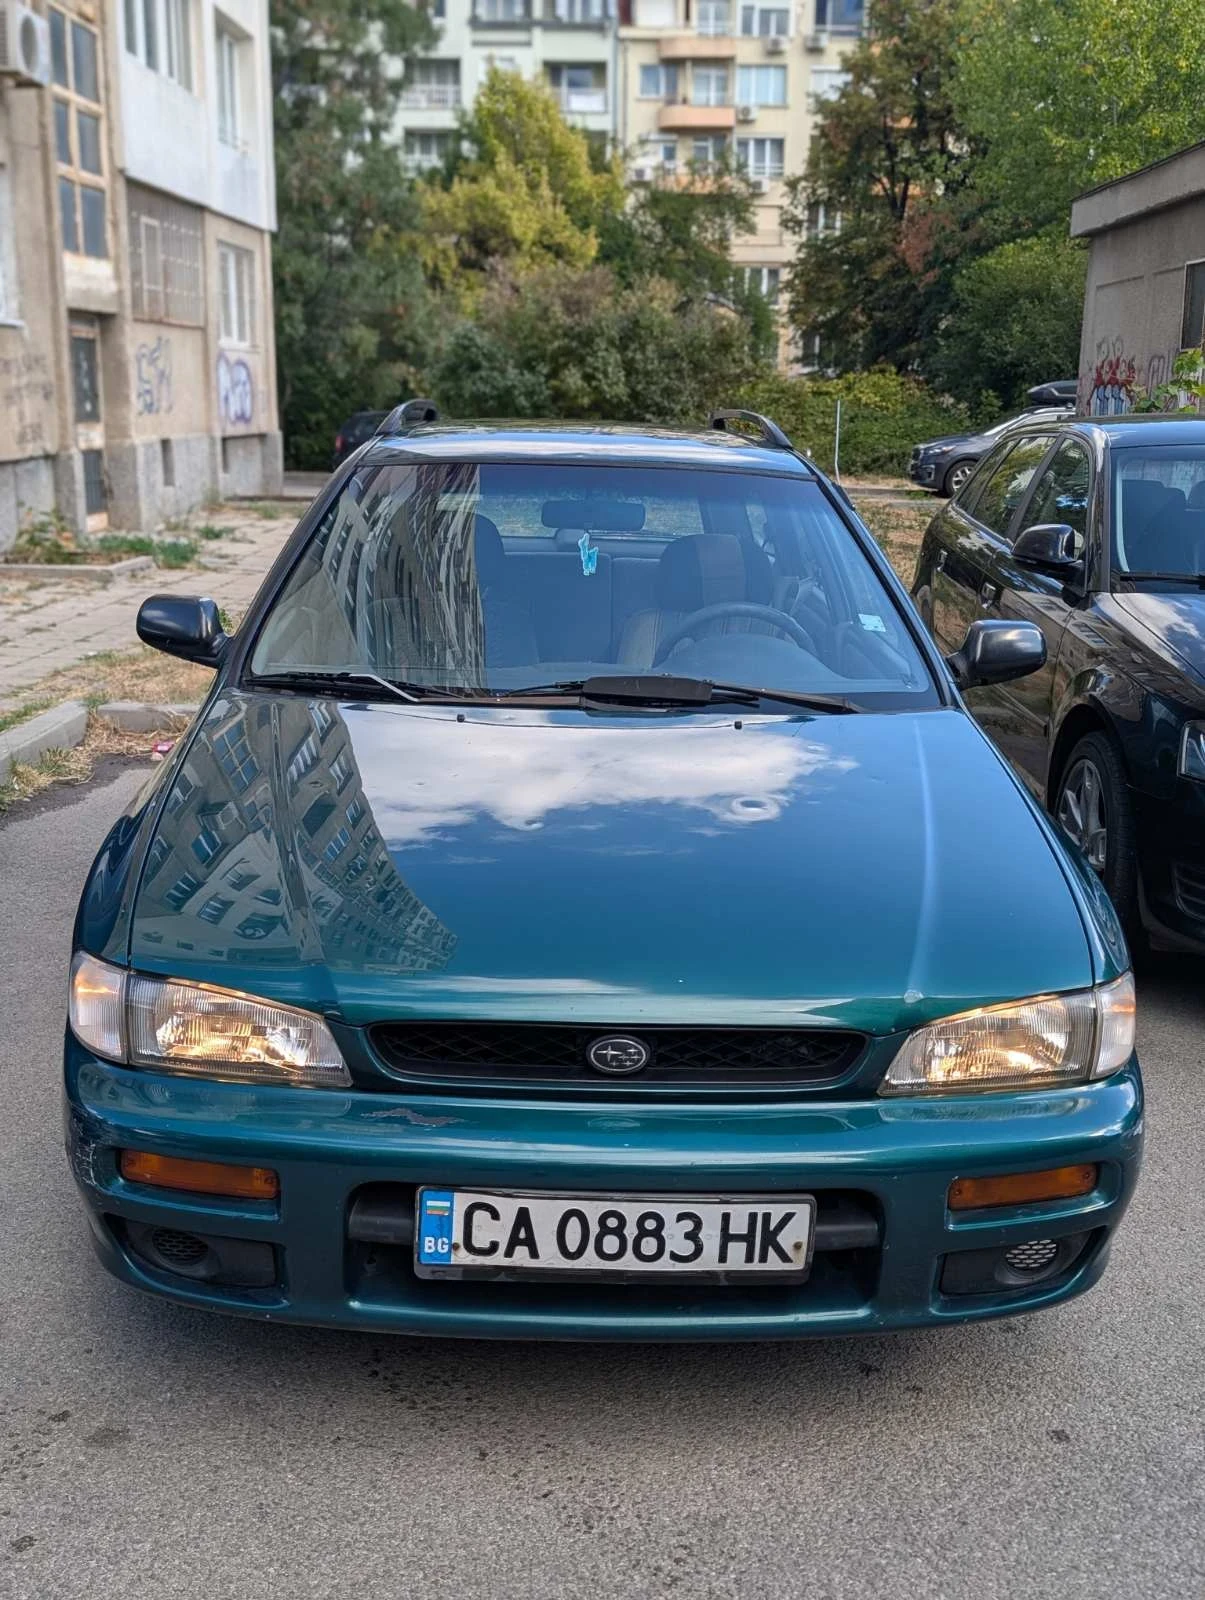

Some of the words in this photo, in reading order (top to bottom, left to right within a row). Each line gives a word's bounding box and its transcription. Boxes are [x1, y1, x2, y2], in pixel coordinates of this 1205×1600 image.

[424, 1236, 449, 1253] BG
[463, 1201, 540, 1260] CA
[556, 1207, 704, 1264] 0883
[718, 1211, 797, 1264] HK
